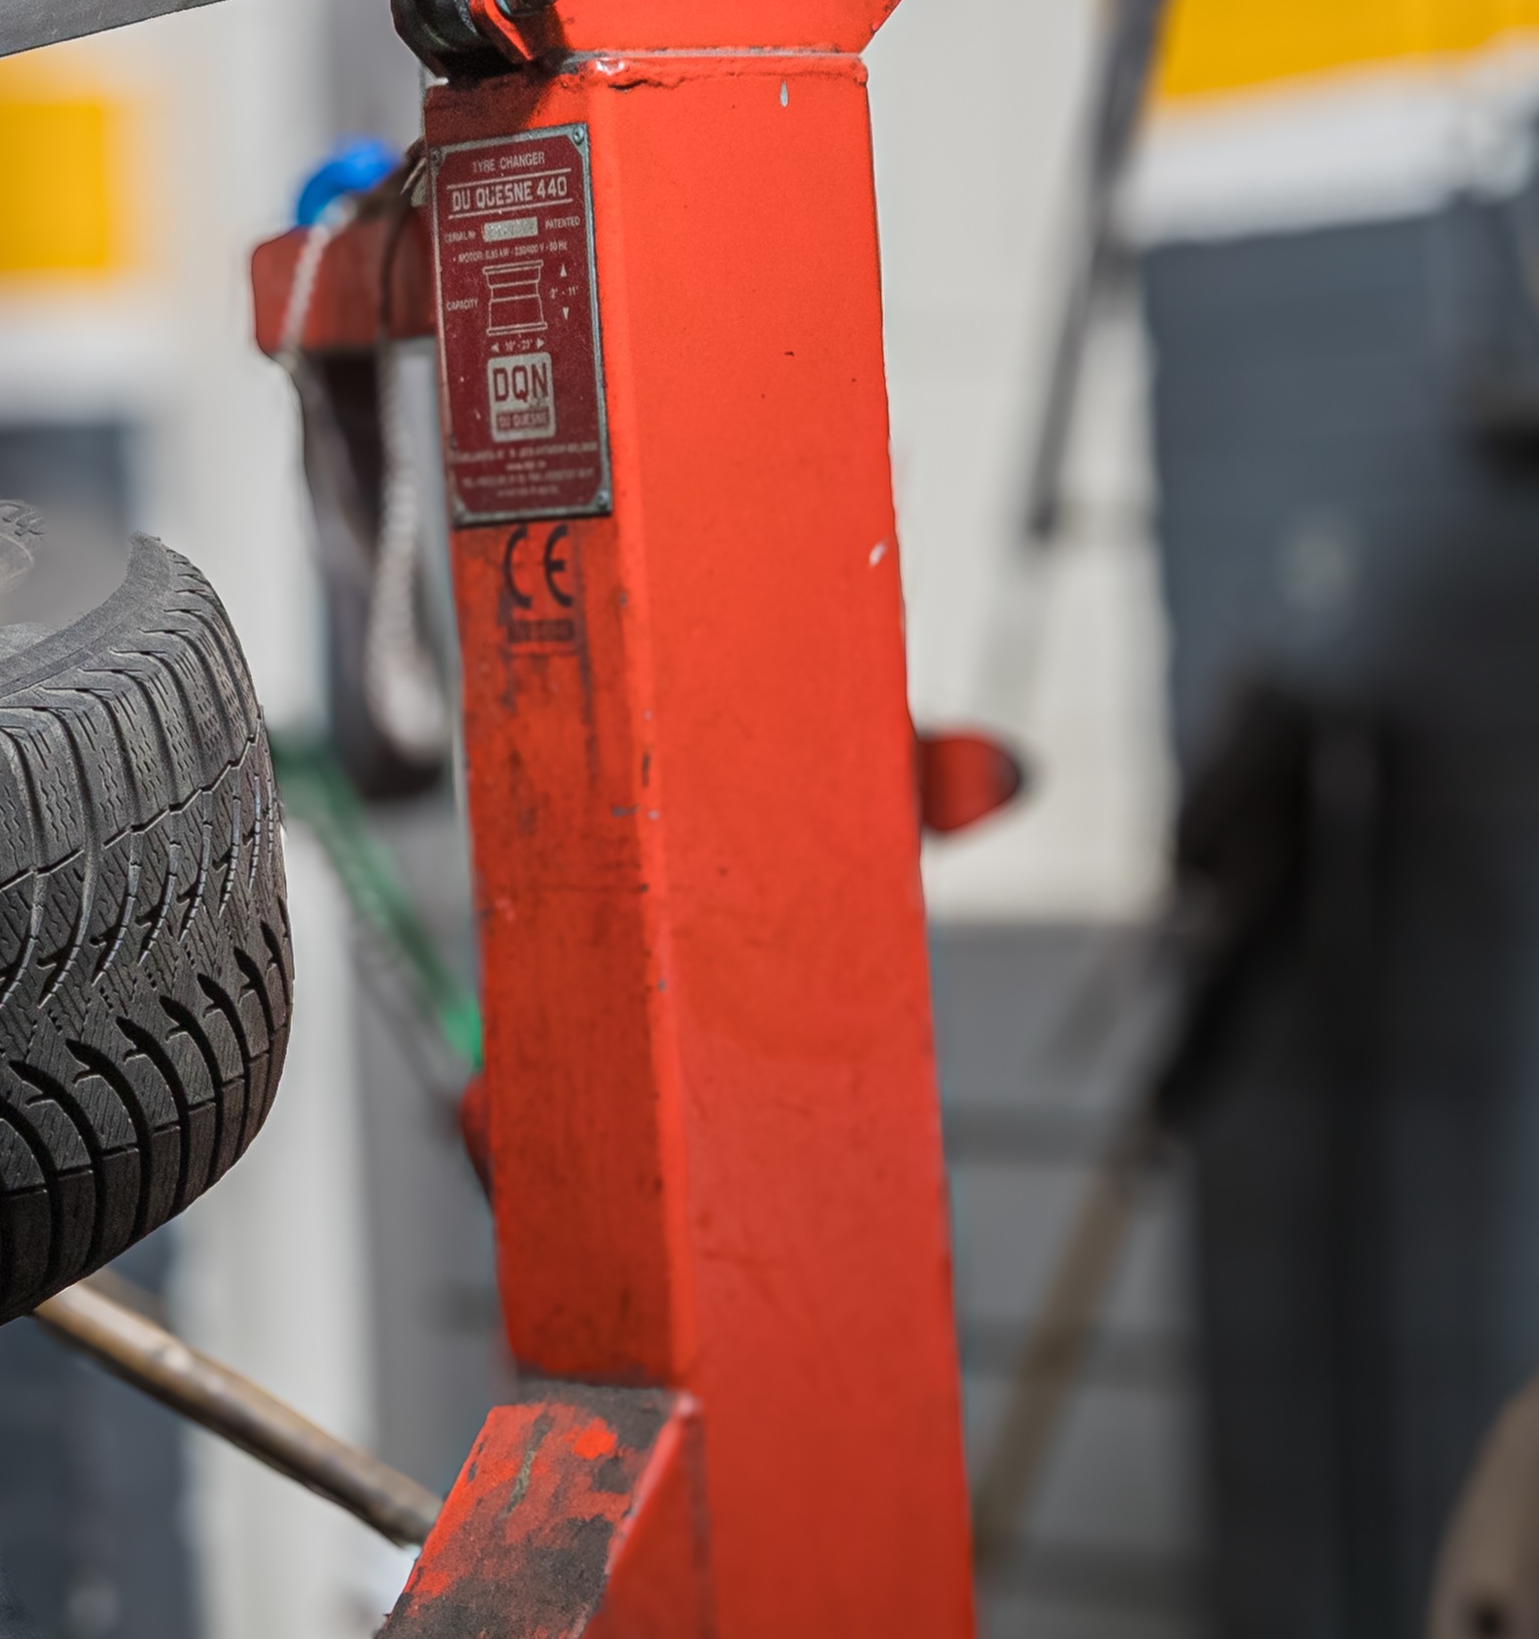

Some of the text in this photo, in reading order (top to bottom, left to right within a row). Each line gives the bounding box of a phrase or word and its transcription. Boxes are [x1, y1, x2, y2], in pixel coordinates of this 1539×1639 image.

[499, 152, 545, 170] CHANGER
[452, 176, 567, 211] DU QUESNE 440
[545, 216, 580, 229] PATENTED
[446, 298, 479, 311] CAPACITY
[493, 362, 549, 403] DQN
